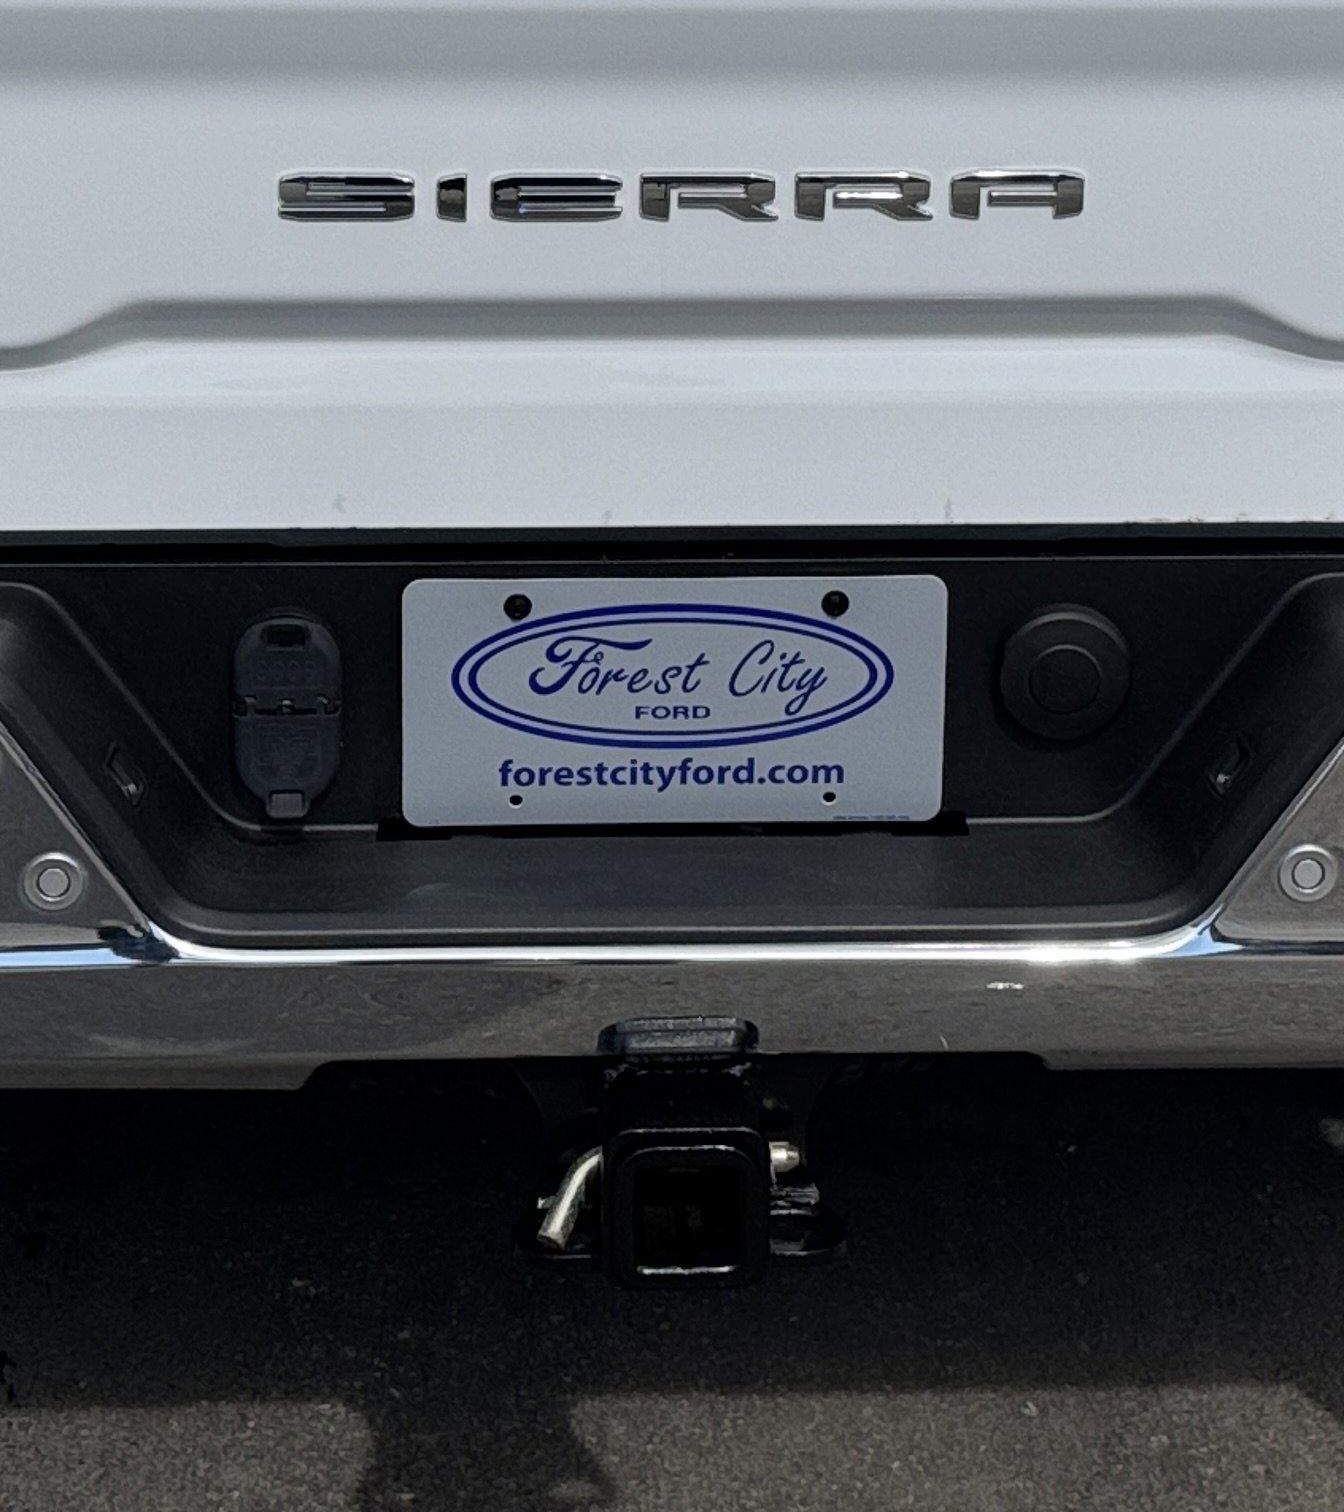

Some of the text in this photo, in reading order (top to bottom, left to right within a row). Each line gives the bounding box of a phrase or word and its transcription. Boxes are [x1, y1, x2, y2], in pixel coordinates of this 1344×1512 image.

[277, 171, 1085, 223] SIERRA
[529, 636, 827, 716] Forest City
[634, 705, 711, 720] FORD
[499, 758, 845, 792] forestcityford.com
